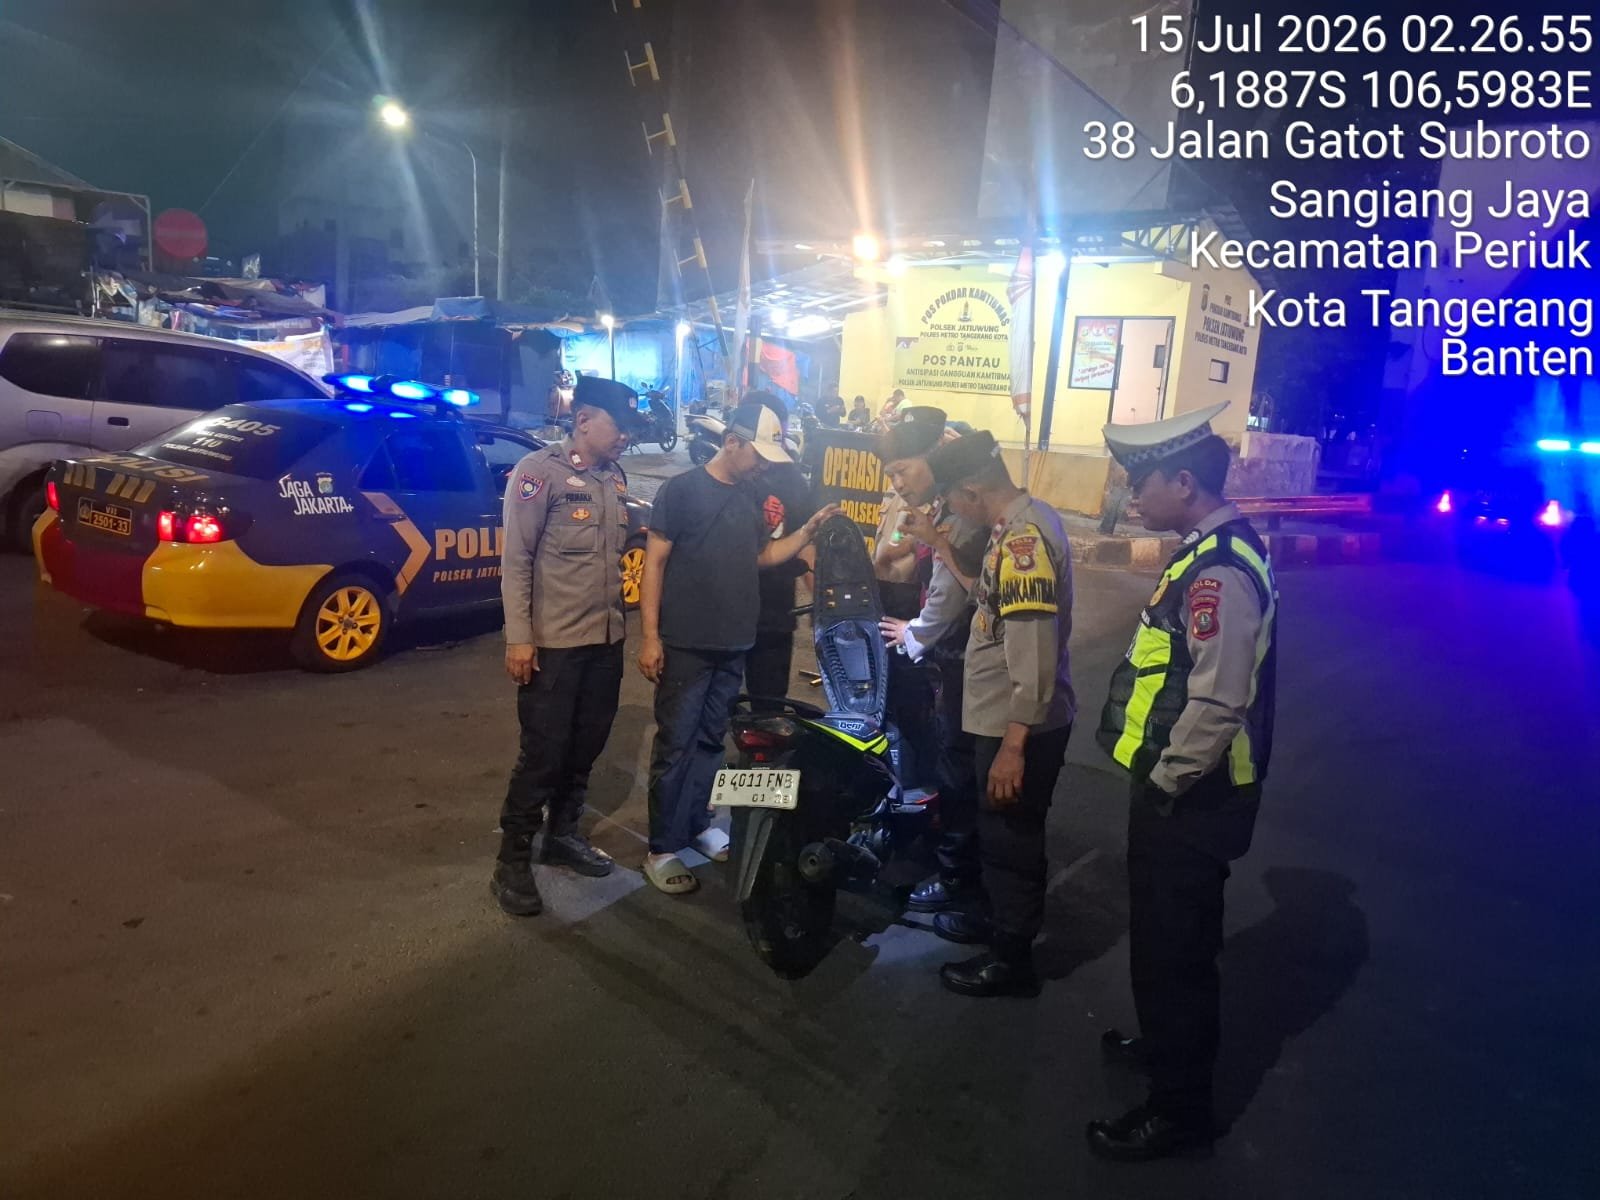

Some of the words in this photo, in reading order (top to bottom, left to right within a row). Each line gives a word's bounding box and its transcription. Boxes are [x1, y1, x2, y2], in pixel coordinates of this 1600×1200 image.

[921, 304, 937, 325] POS
[935, 287, 967, 309] POKDAR
[929, 323, 956, 331] POLSEK
[957, 324, 999, 333] JATIUWUNG
[922, 354, 946, 366] POS
[949, 355, 1000, 368] PANTAU
[192, 437, 223, 448] 110
[823, 446, 882, 492] OPERASI
[279, 474, 314, 498] JAGA
[433, 569, 472, 583] POLSEK
[718, 773, 726, 787] B
[730, 773, 762, 787] 4011
[767, 773, 793, 788] FNB
